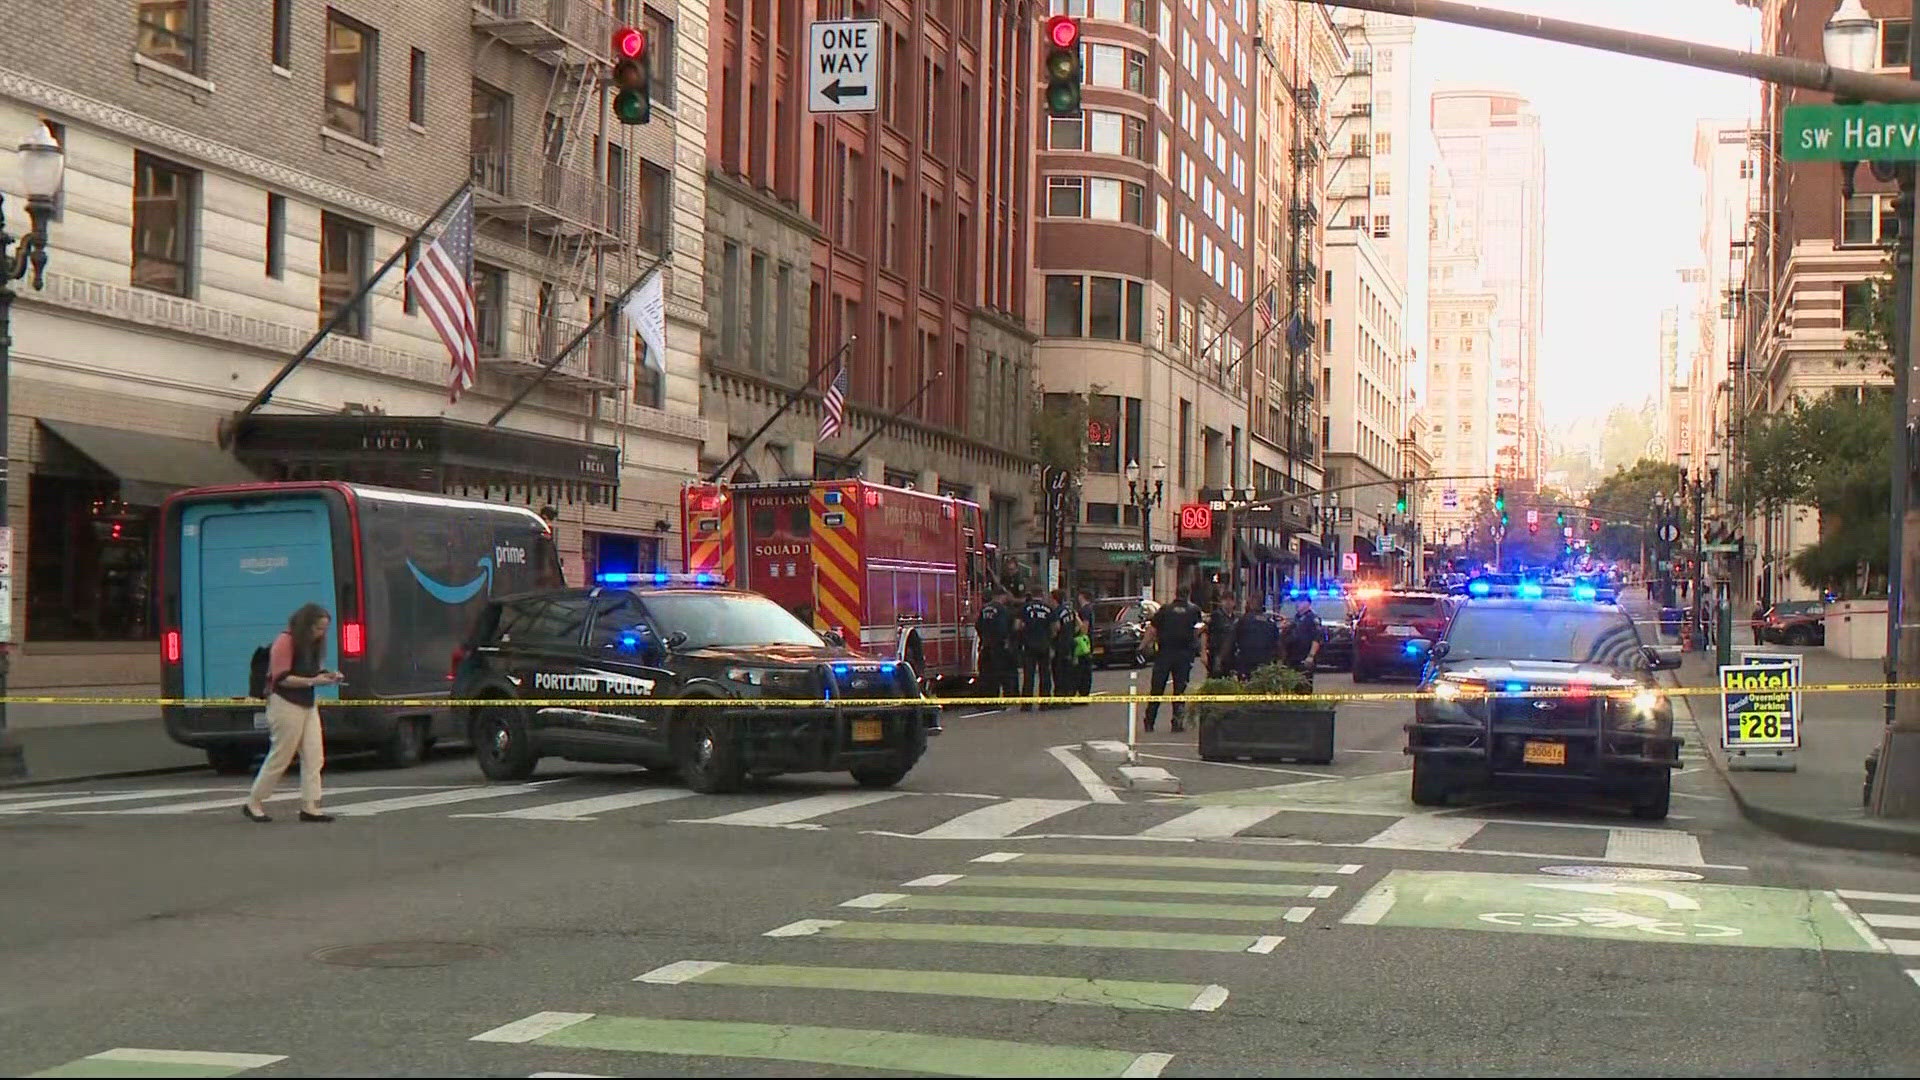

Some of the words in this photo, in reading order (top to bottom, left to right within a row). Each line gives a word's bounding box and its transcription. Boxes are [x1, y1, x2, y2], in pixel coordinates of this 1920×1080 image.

[822, 29, 868, 50] ONE
[820, 53, 869, 74] WAY
[1801, 128, 1832, 149] SW
[1844, 118, 1920, 149] Harv
[363, 437, 424, 449] LUCIA
[752, 495, 810, 507] PORTLAND
[755, 544, 800, 556] SQUAD
[1102, 542, 1125, 551] JAVA
[1127, 543, 1145, 552] MA
[1149, 544, 1177, 553] COFFEE
[496, 543, 526, 568] prime
[535, 672, 598, 692] PORTLAND
[606, 677, 653, 696] POLICE
[1727, 671, 1789, 690] Hotel
[1749, 693, 1790, 703] Overnight
[1754, 702, 1785, 712] Parking
